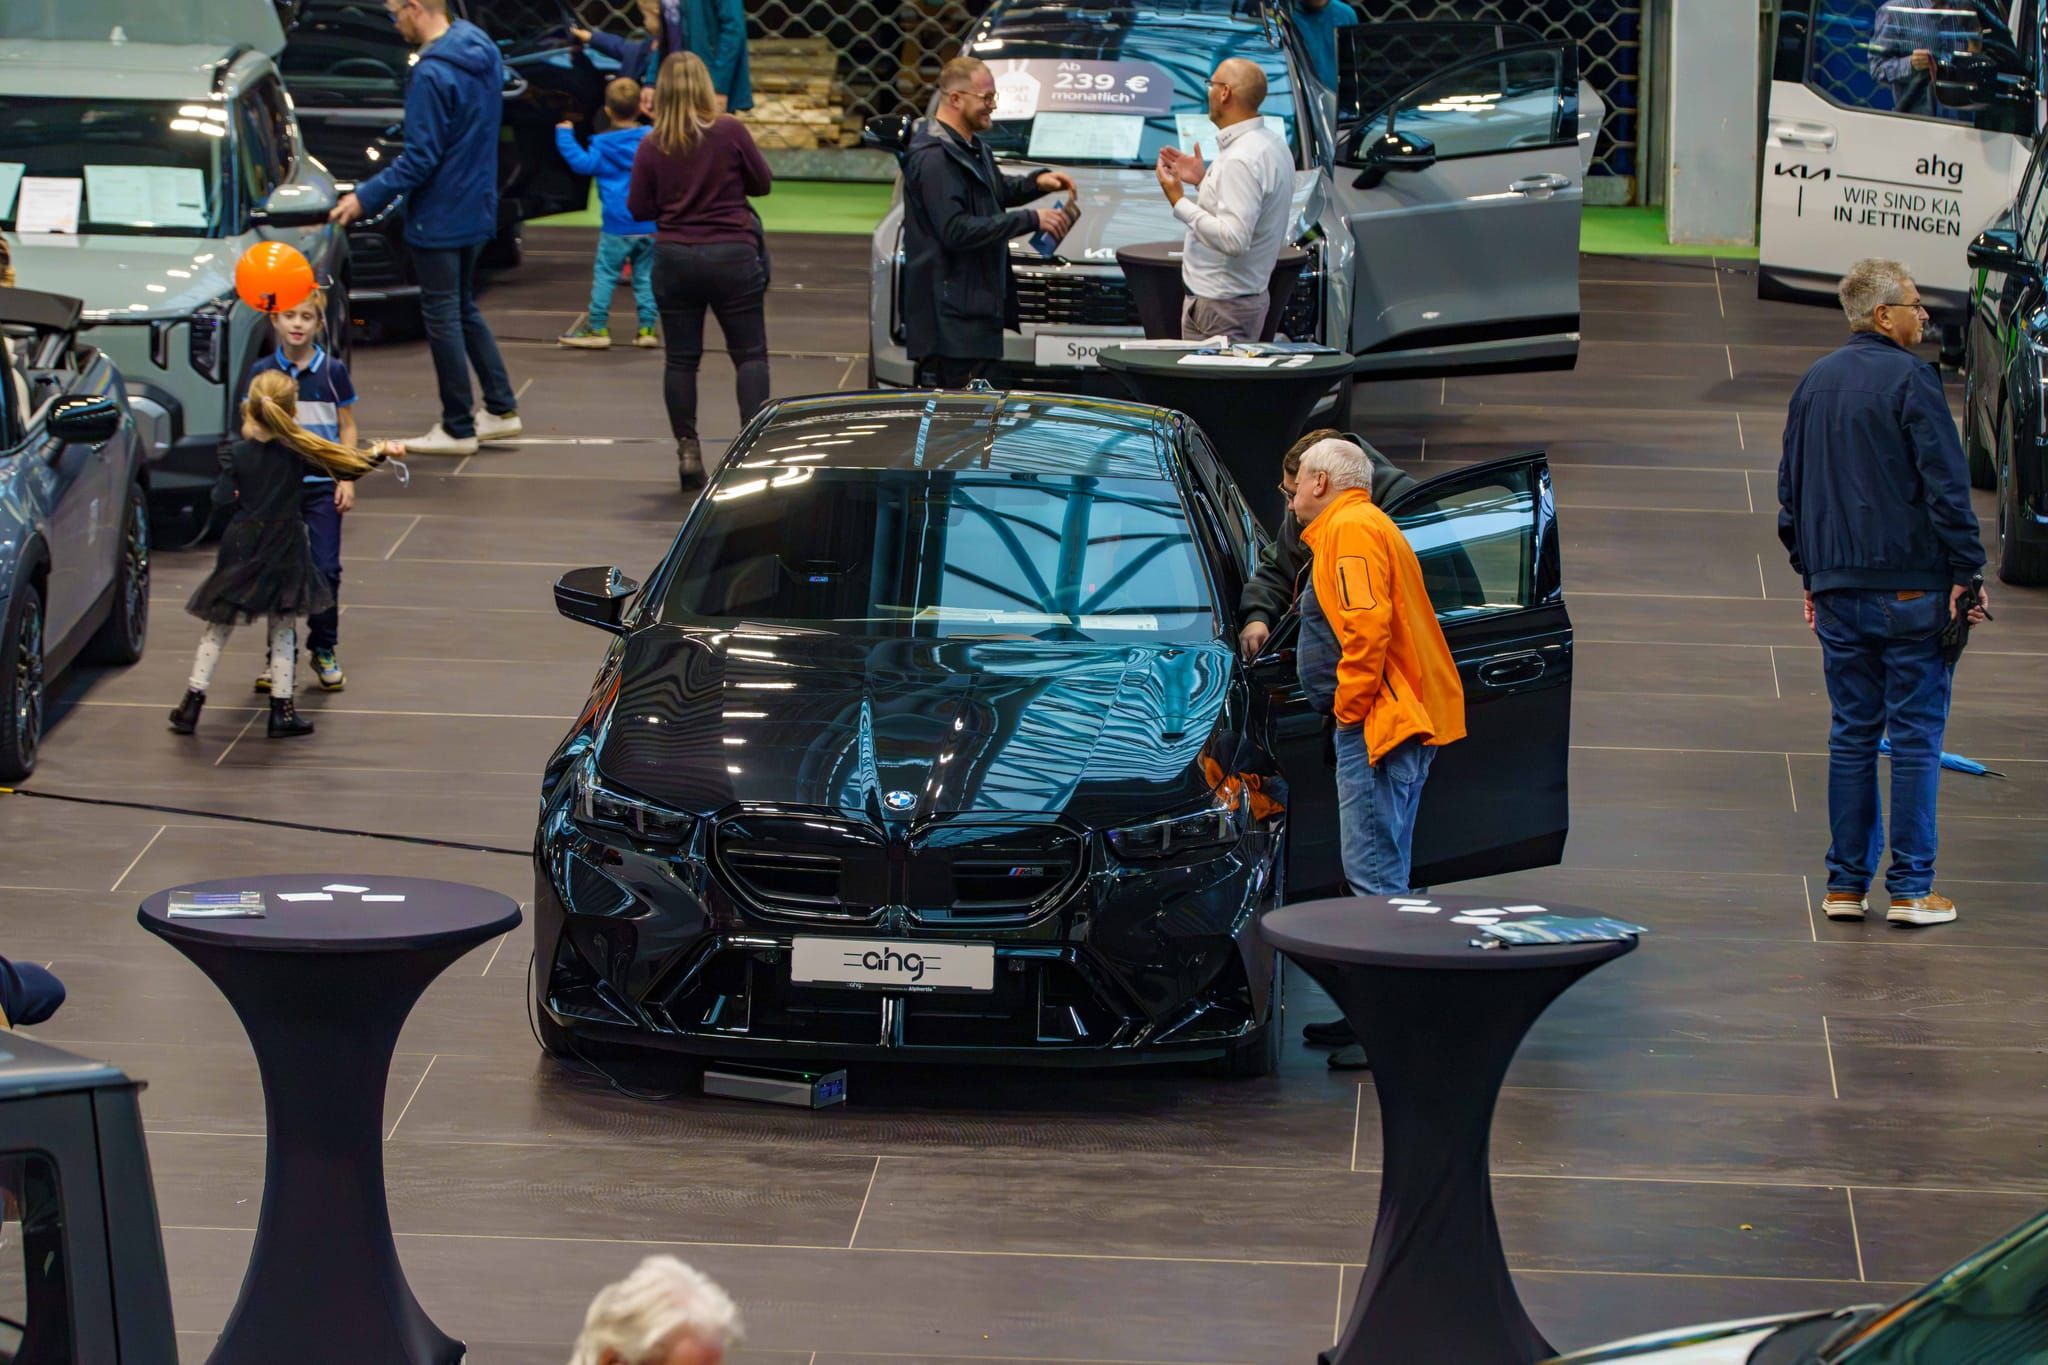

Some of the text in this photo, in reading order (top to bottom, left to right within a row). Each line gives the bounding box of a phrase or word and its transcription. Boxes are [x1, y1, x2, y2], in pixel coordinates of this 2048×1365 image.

[1057, 62, 1080, 71] Ab
[1053, 73, 1150, 93] 239 €
[1774, 162, 1831, 182] KIA
[1915, 154, 1963, 185] ahg
[1844, 186, 1961, 217] WIR SIND KIA
[1834, 205, 1961, 237] IN JETTINGEN
[1067, 342, 1099, 360] Spo
[862, 947, 924, 982] ahg
